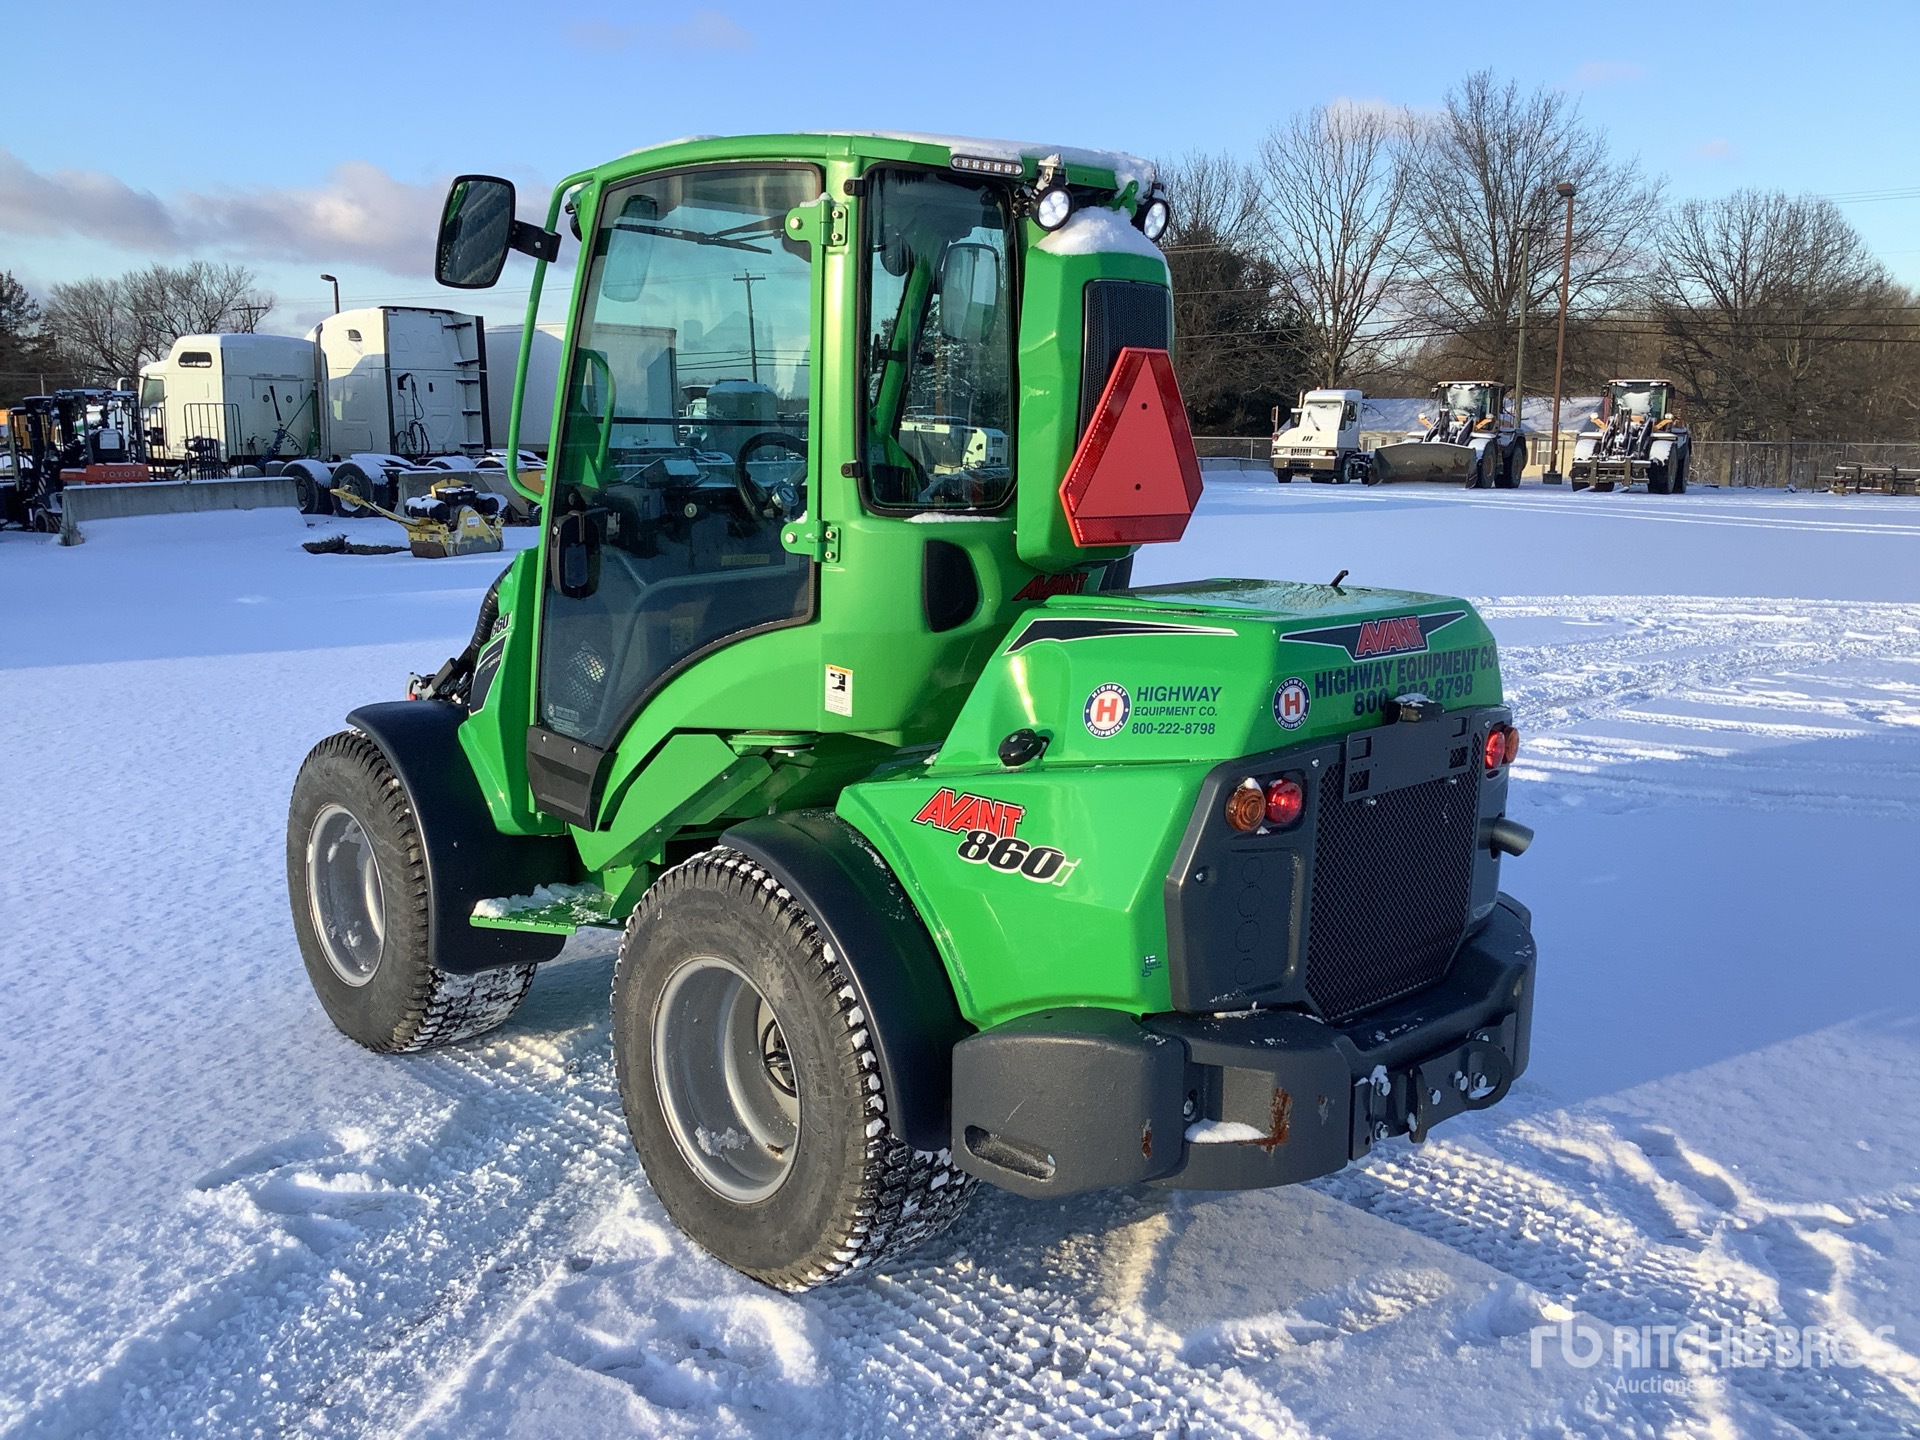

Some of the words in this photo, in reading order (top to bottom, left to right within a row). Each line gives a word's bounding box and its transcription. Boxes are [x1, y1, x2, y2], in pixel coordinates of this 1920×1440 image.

[1011, 573, 1089, 601] AVANT
[1354, 615, 1425, 658] AVANT
[1314, 660, 1394, 699] HIGHWAY
[1397, 648, 1479, 684] EQUIPMENT
[1092, 685, 1127, 699] HIGHWAY
[1136, 686, 1222, 702] HIGHWAY
[1277, 680, 1306, 694] HIGHWAY
[1096, 698, 1118, 722] H
[1134, 706, 1196, 716] EQUIPMENT
[1198, 706, 1218, 716] CO.
[1284, 691, 1300, 717] H
[1086, 720, 1124, 737] EQUIPMENT
[1132, 722, 1216, 735] 800-222-8798
[1277, 712, 1307, 728] EQUIPMENT
[911, 786, 1025, 838] AVANT
